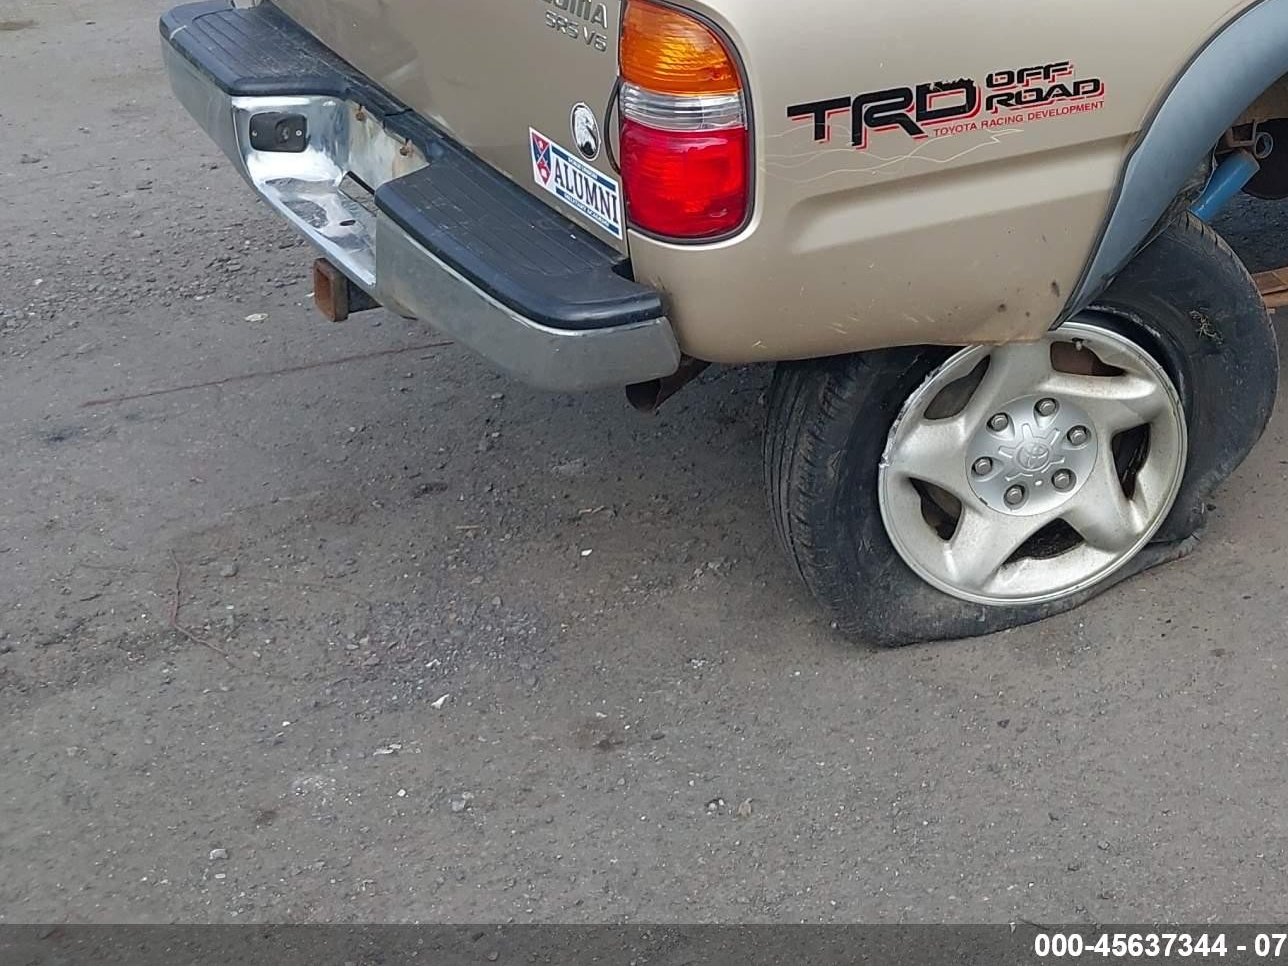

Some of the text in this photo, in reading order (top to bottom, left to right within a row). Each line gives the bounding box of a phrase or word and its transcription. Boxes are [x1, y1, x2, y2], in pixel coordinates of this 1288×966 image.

[583, 26, 608, 52] V6
[986, 60, 1074, 90] OFF
[786, 77, 982, 150] TRD
[986, 78, 1105, 115] ROAD
[934, 100, 1105, 137] TOYOTA RACING DEVELOPMENT
[554, 156, 618, 224] ALUMNI
